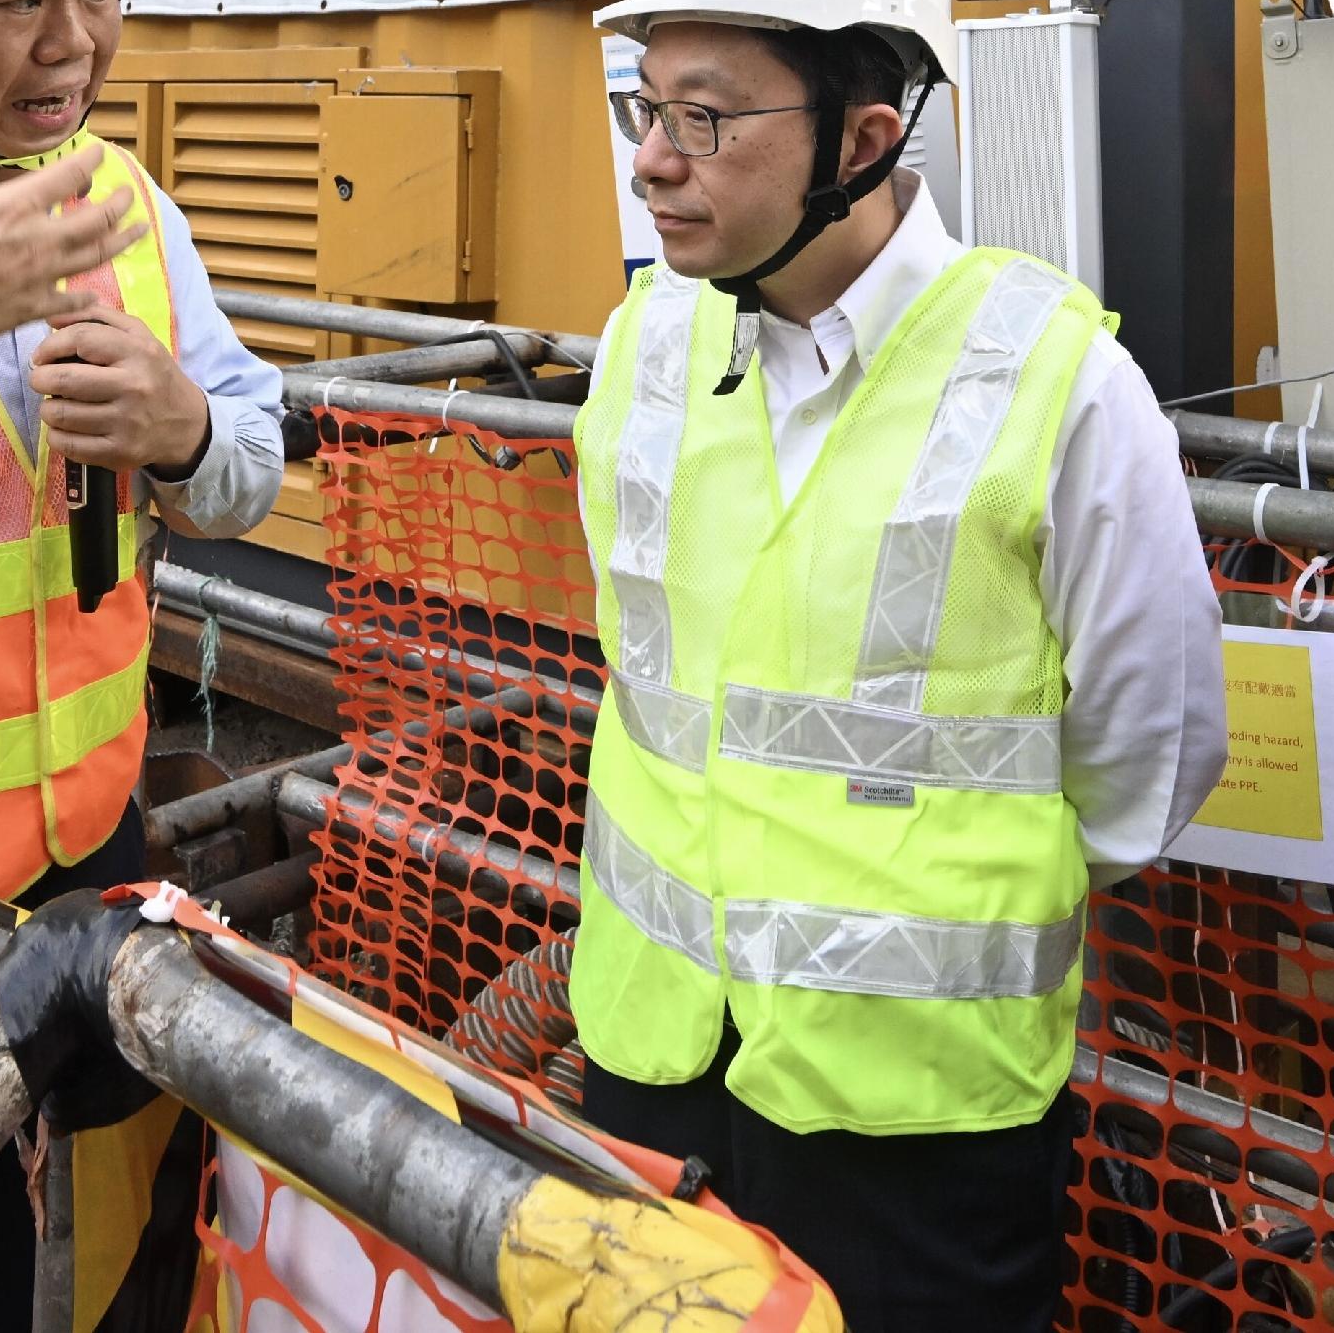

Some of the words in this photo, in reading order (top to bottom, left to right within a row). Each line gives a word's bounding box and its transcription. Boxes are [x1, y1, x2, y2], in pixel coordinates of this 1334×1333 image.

[1263, 734, 1304, 749] hazard,
[1245, 756, 1253, 767] is
[1255, 758, 1299, 772] allowed
[1239, 781, 1264, 793] PPE.
